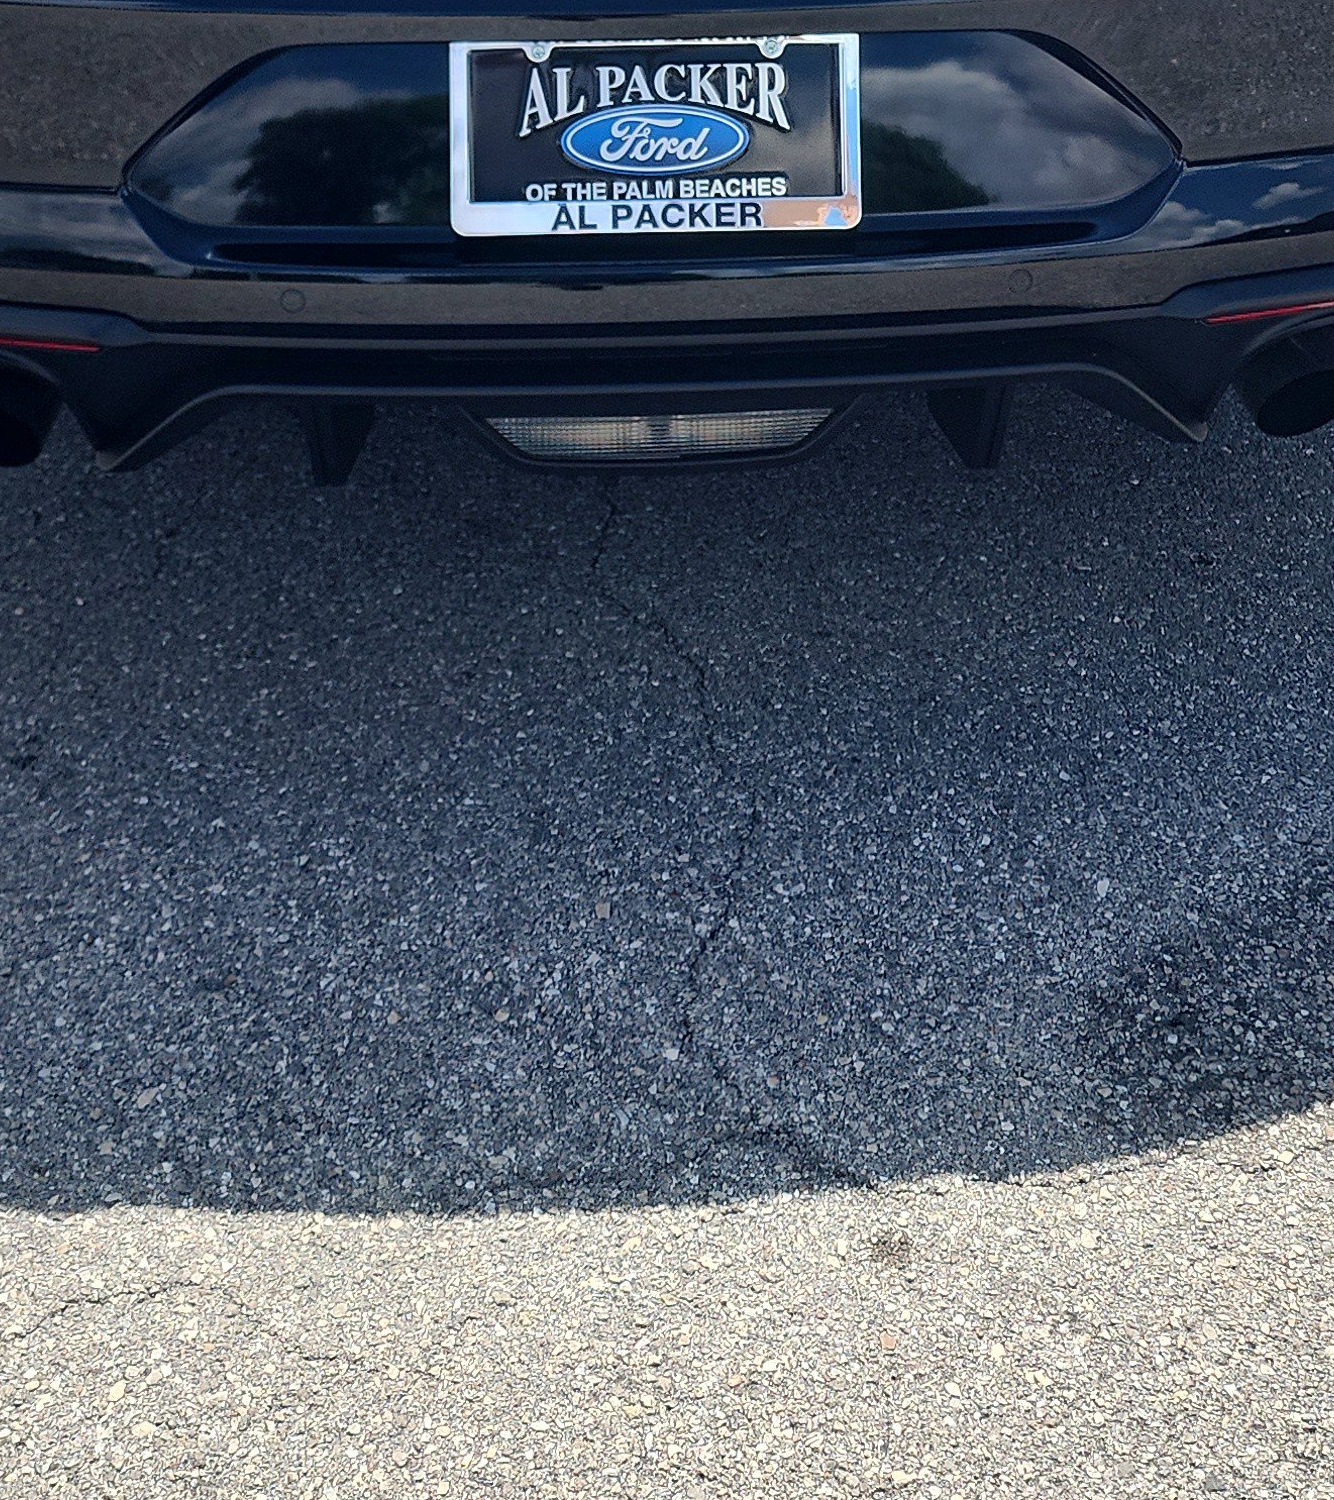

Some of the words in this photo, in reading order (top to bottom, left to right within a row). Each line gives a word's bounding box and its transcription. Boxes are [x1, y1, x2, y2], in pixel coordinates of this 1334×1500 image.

[519, 66, 585, 137] AL
[595, 61, 791, 132] PACKER
[599, 116, 711, 163] Ford
[525, 183, 557, 201] OF
[561, 181, 607, 201] THE
[613, 179, 675, 200] PALM
[679, 176, 787, 198] BEACHES
[551, 203, 597, 231] AL
[611, 202, 763, 230] PACKER
